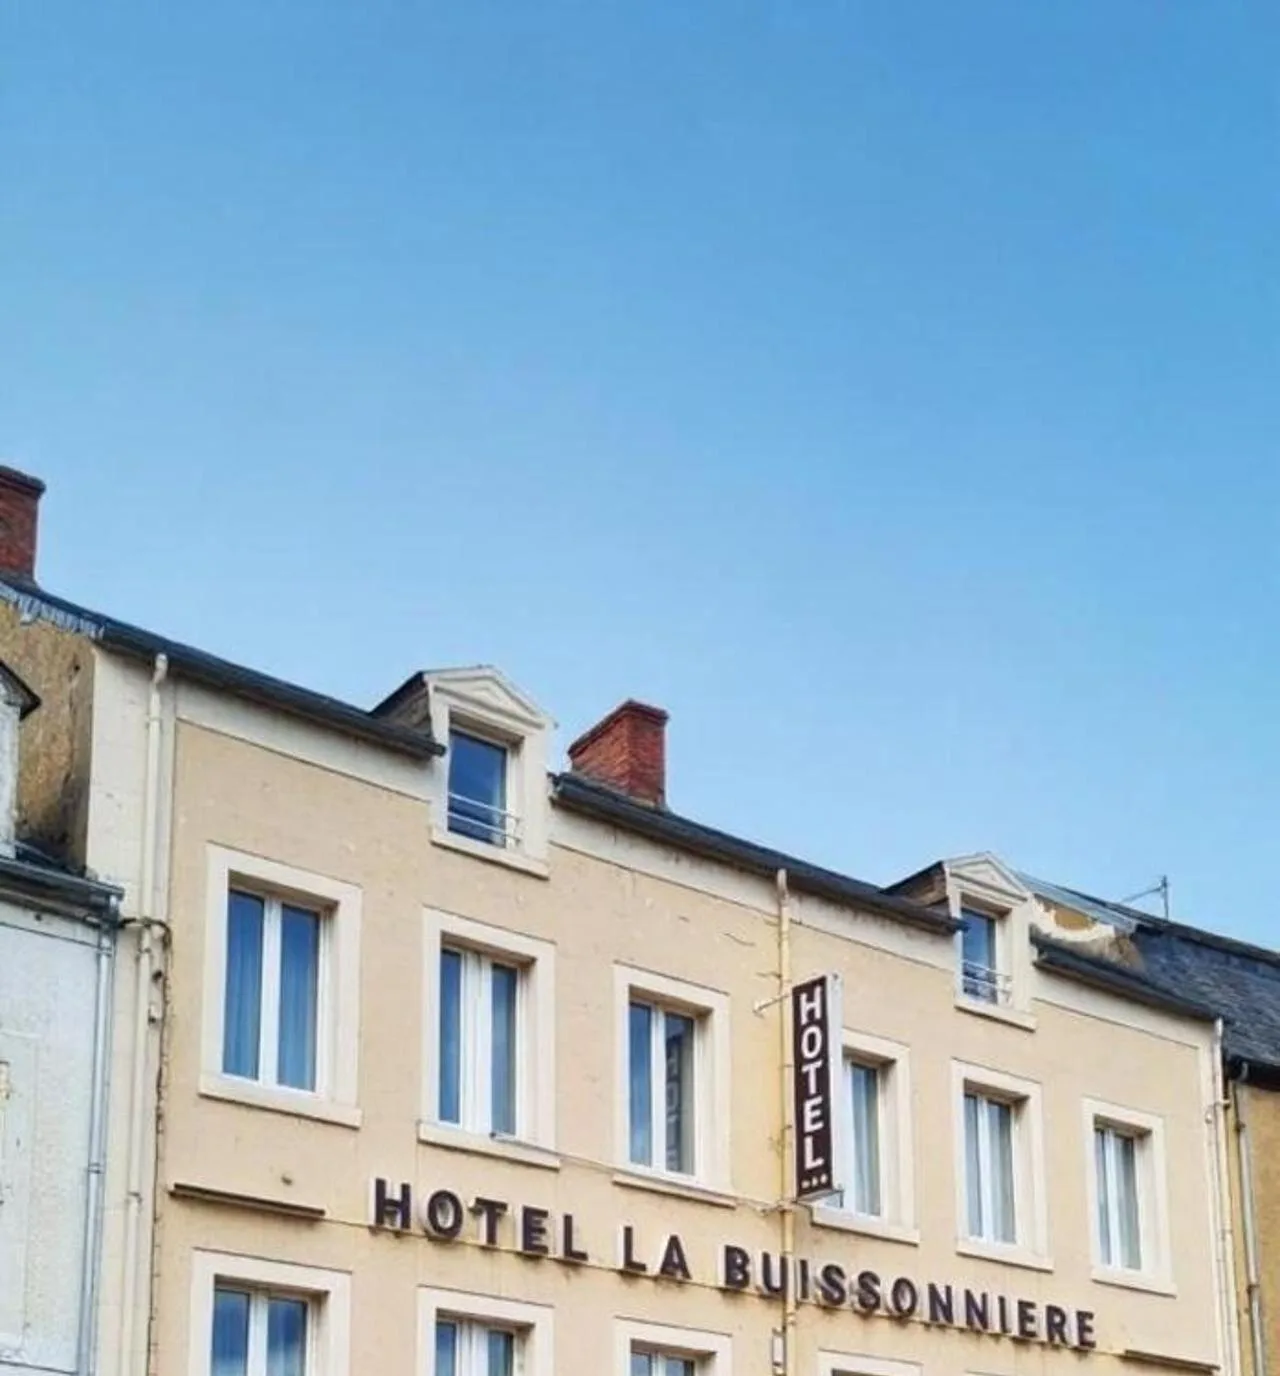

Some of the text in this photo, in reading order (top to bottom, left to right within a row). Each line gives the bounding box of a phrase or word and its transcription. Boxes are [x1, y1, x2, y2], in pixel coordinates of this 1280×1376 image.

[800, 985, 824, 1170] HOTEL
[373, 1177, 1098, 1349] HOTEL LA BUISSONNIERE
